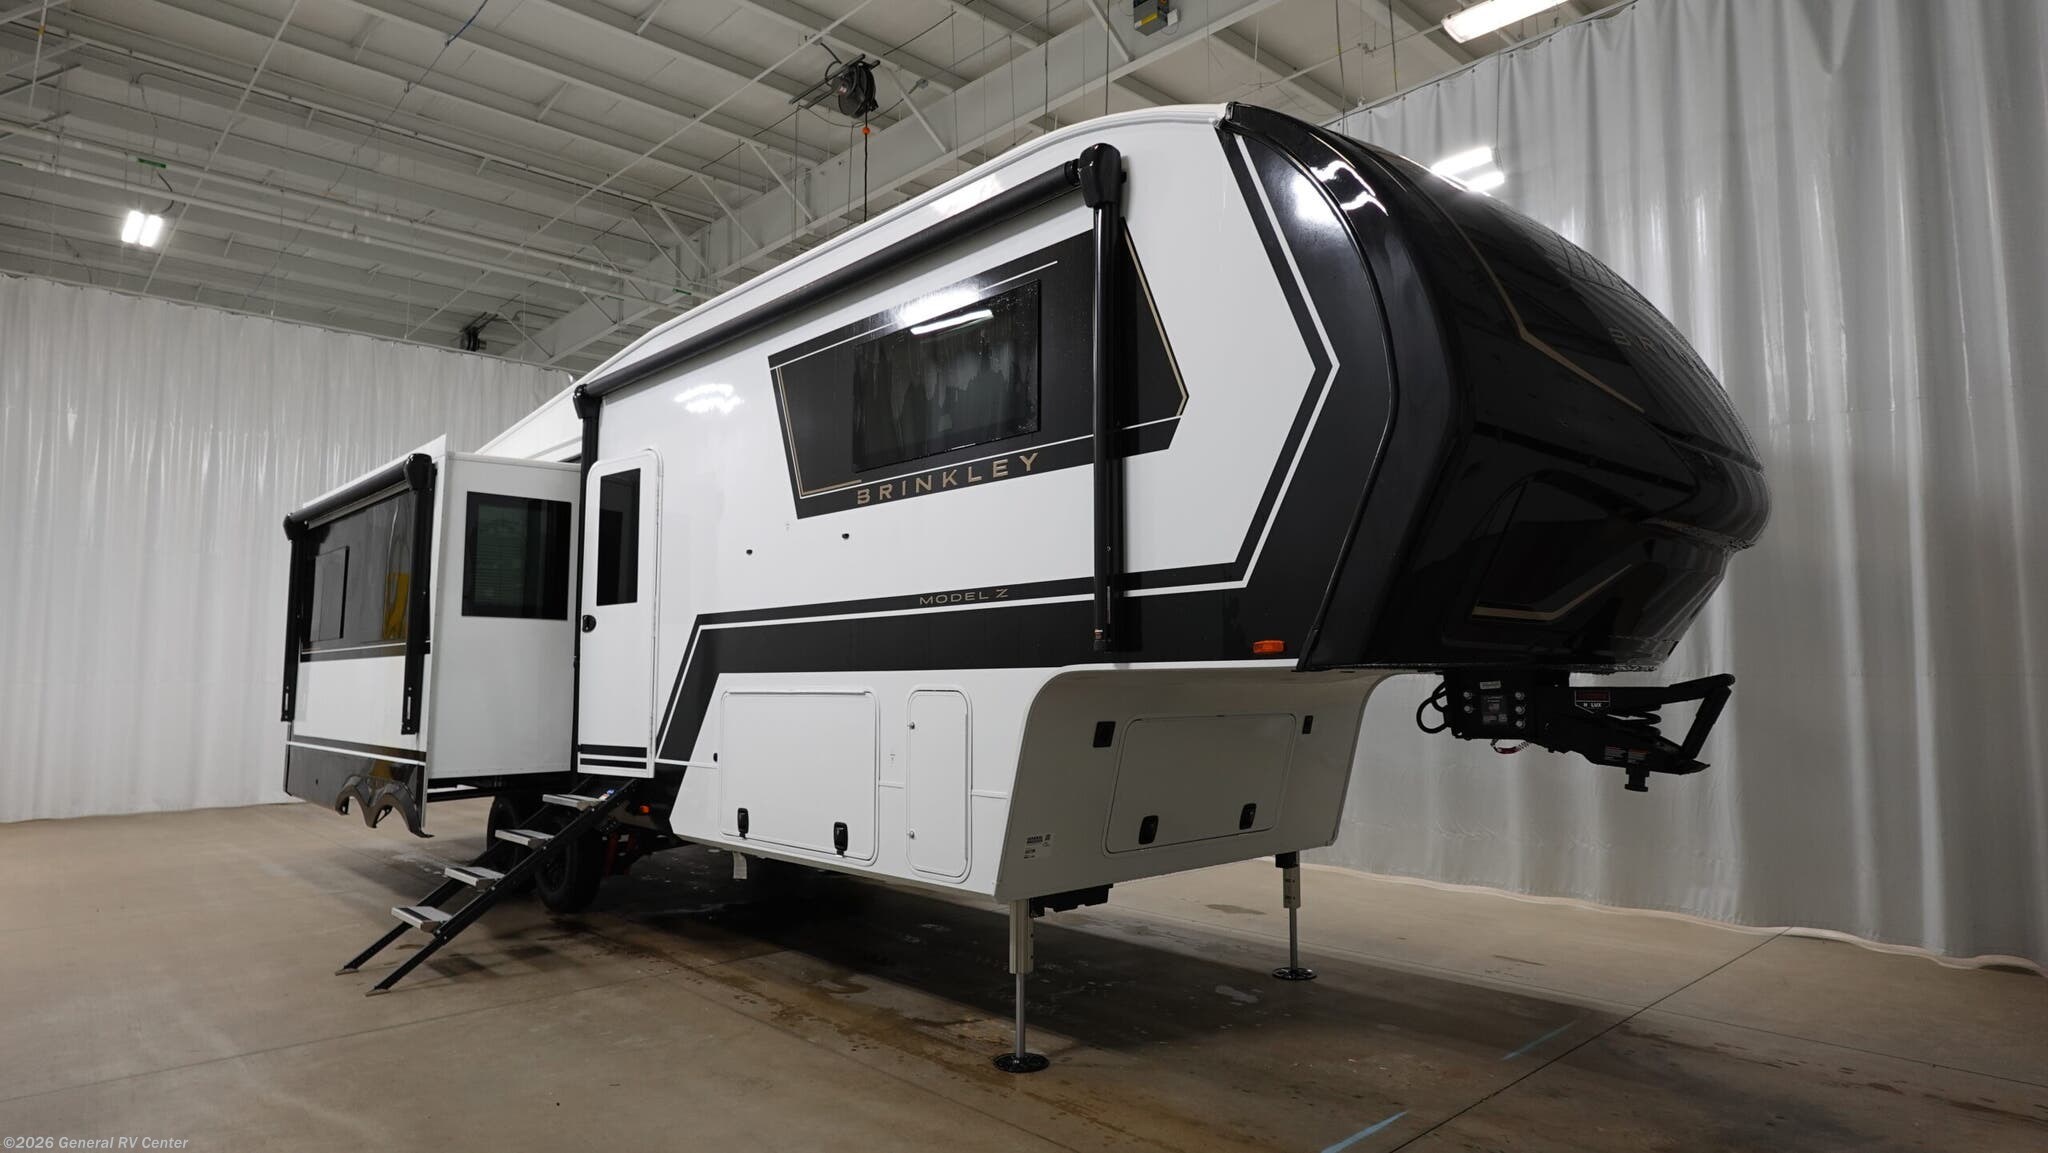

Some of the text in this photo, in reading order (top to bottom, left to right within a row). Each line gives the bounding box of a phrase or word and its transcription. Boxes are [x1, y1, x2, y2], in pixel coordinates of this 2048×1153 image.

[856, 452, 1039, 505] BRINKLEY
[919, 588, 1009, 605] MODEL Z
